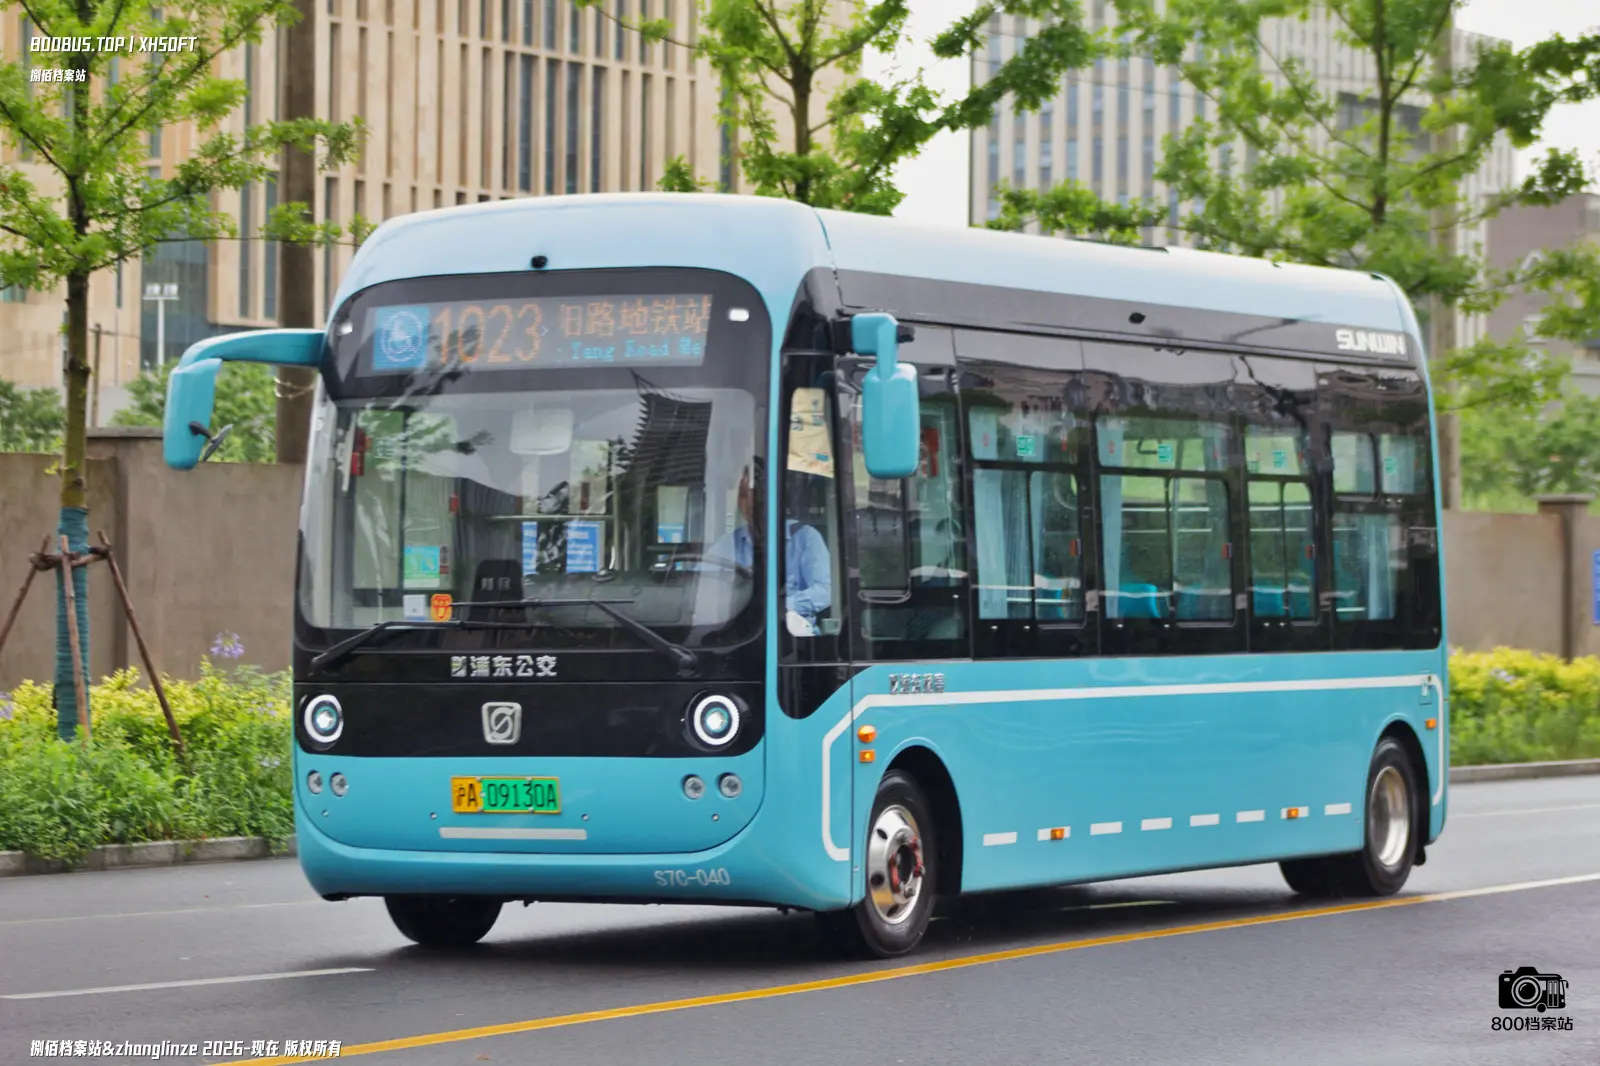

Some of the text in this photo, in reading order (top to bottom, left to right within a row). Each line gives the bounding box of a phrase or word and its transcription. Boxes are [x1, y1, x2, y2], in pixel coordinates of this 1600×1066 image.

[434, 303, 543, 365] 1023
[1335, 328, 1407, 355] SUNWIN
[624, 338, 670, 358] Road
